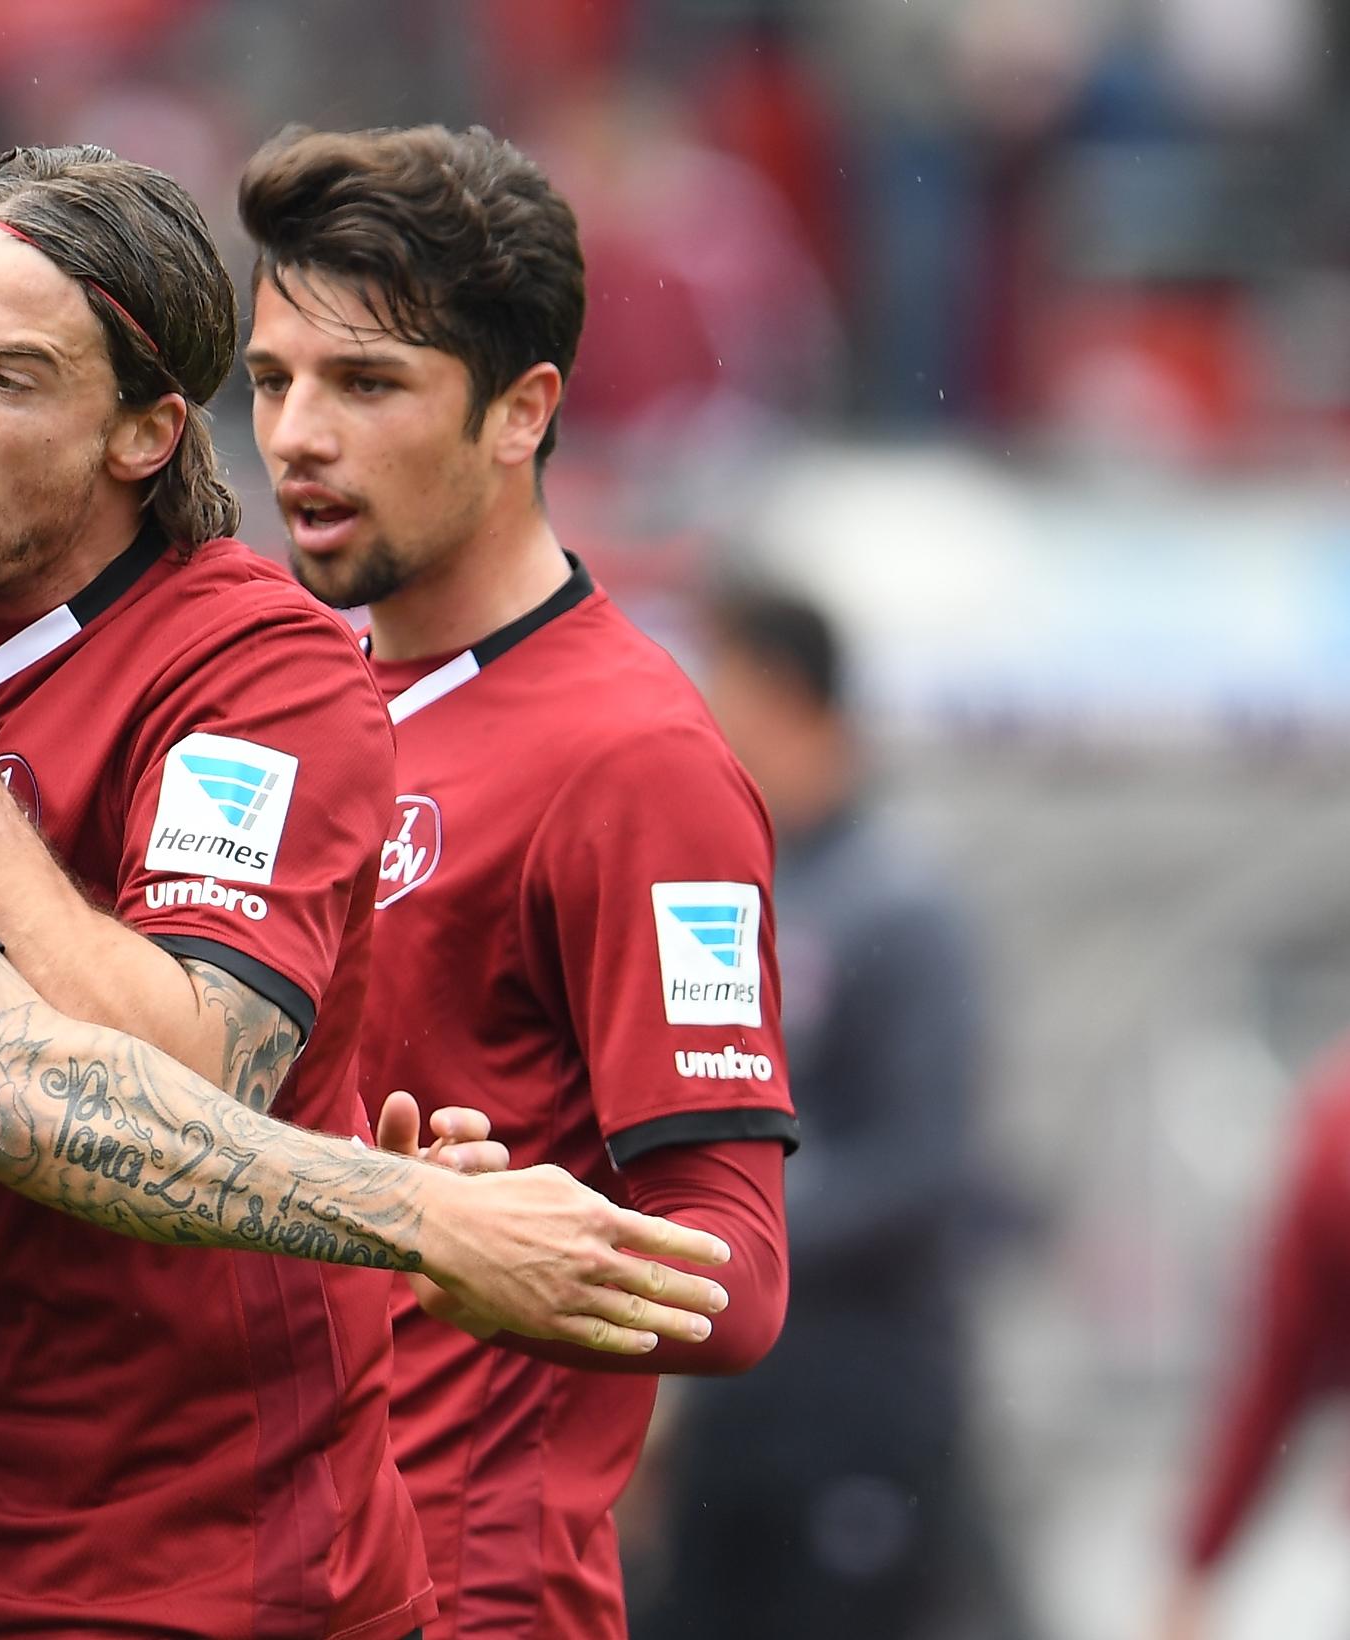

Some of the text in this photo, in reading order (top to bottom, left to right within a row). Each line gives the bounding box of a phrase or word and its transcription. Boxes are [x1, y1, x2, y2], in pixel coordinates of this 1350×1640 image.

[155, 827, 269, 870] Hermes
[145, 876, 268, 921] umbro
[671, 978, 755, 1004] Hermes
[674, 1045, 773, 1082] umbro
